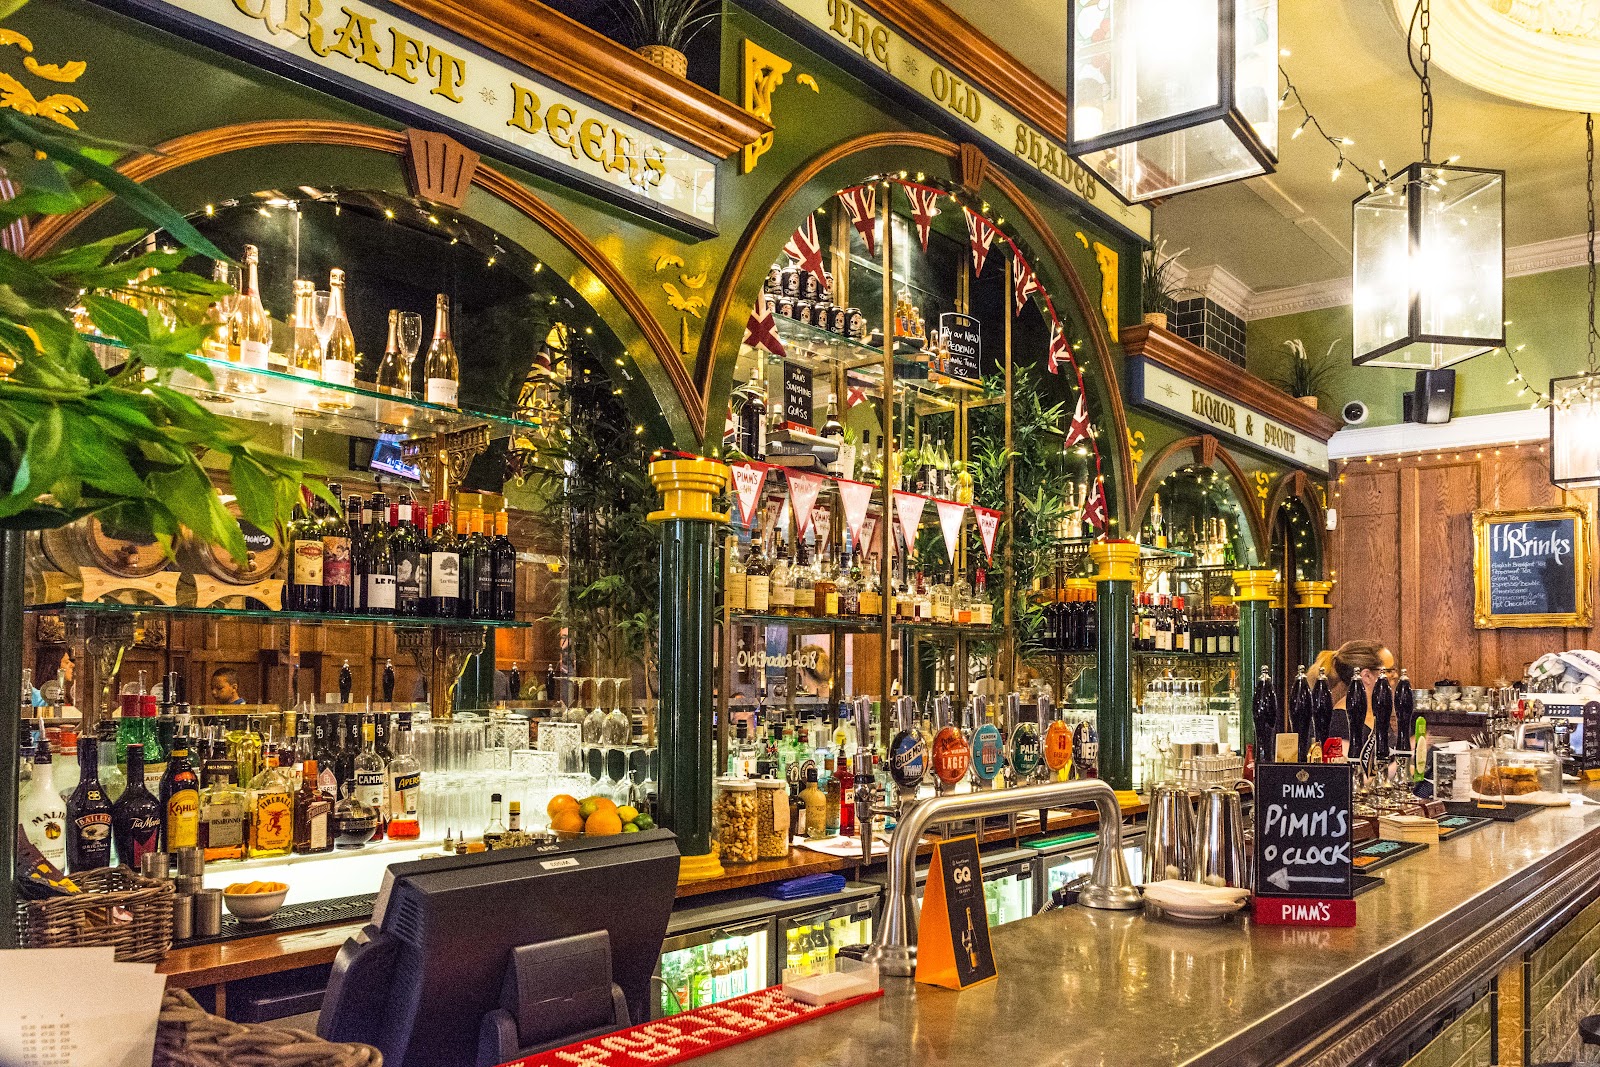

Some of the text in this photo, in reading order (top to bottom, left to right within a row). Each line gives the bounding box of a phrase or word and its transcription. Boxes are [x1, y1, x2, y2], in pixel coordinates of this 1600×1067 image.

[929, 65, 982, 124] OLD
[506, 82, 669, 190] BEERS
[785, 380, 812, 399] SUNSHINE
[790, 394, 803, 406] IN A
[787, 404, 808, 420] GLASS
[1191, 389, 1296, 455] LIQUOR & STOUT
[736, 471, 758, 486] PIMM'S
[1491, 522, 1571, 566] Hot Drinks
[1020, 744, 1038, 755] PALE
[1023, 754, 1034, 762] ALE
[895, 752, 912, 768] BLUE
[942, 756, 969, 770] LAGER
[1282, 781, 1325, 799] PIMM'S
[259, 796, 291, 810] FIREBALL
[1281, 842, 1351, 866] CLOCK
[953, 866, 972, 885] GQ
[1281, 901, 1331, 921] PIMM'S
